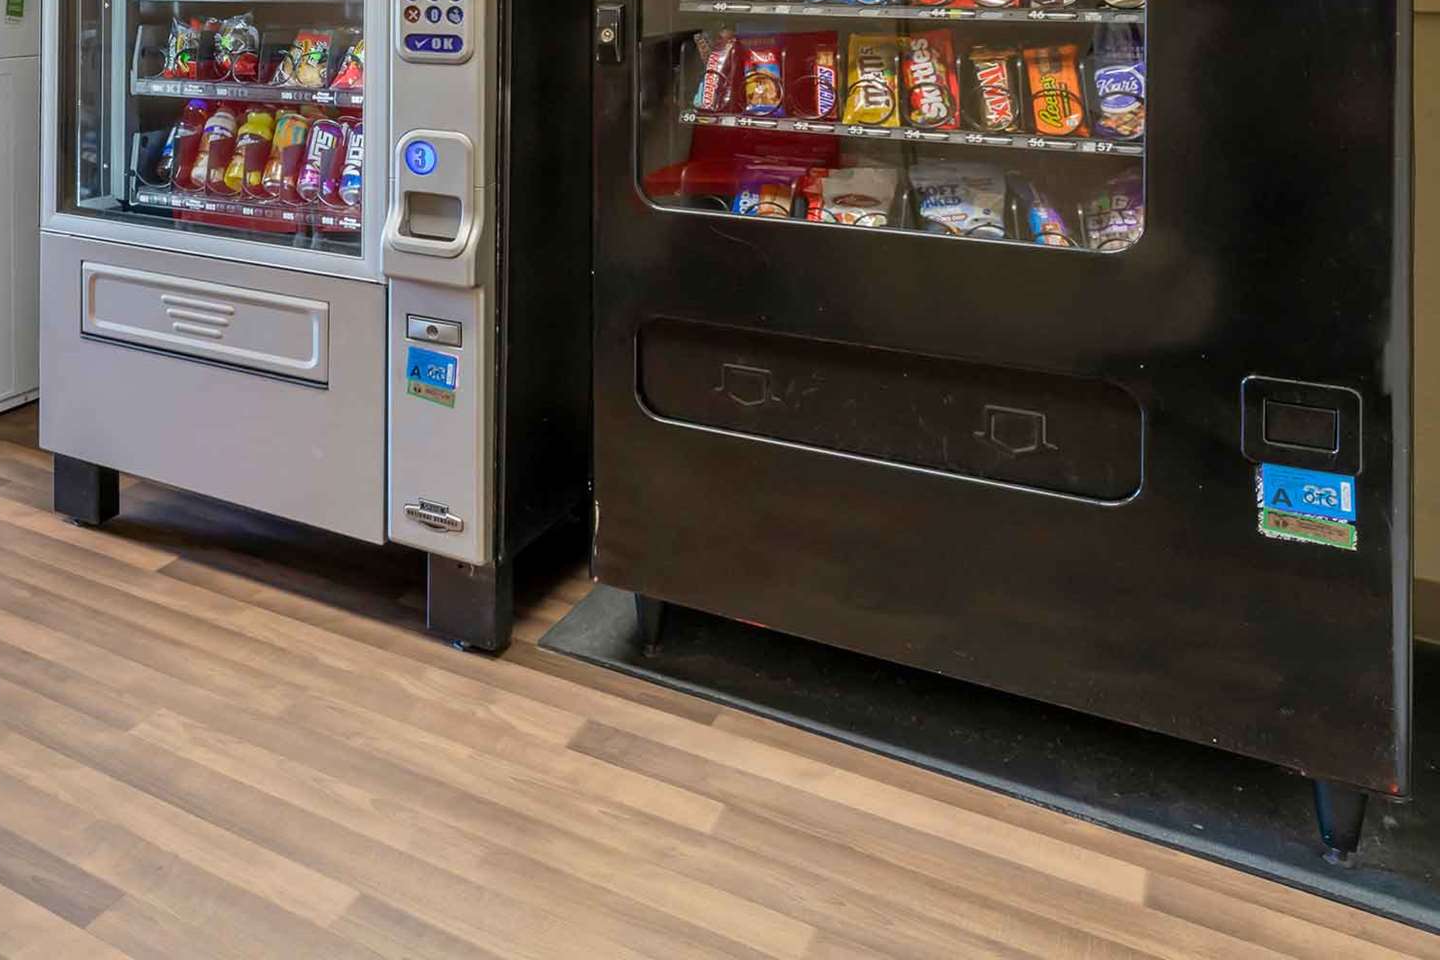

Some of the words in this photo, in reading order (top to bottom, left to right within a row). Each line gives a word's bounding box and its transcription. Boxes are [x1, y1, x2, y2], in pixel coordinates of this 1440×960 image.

[431, 9, 439, 21] 0
[930, 9, 946, 17] 44
[1029, 10, 1044, 20] 46
[431, 38, 455, 50] OK
[910, 37, 949, 121] Skittles
[683, 113, 696, 122] 50
[739, 117, 752, 126] 51
[848, 126, 864, 135] 53
[905, 129, 920, 139] 54
[966, 134, 983, 143] 55
[1028, 138, 1046, 148] 56
[1095, 142, 1113, 153] 57
[414, 147, 426, 169] 3
[410, 365, 422, 380] A
[1271, 487, 1293, 508] A
